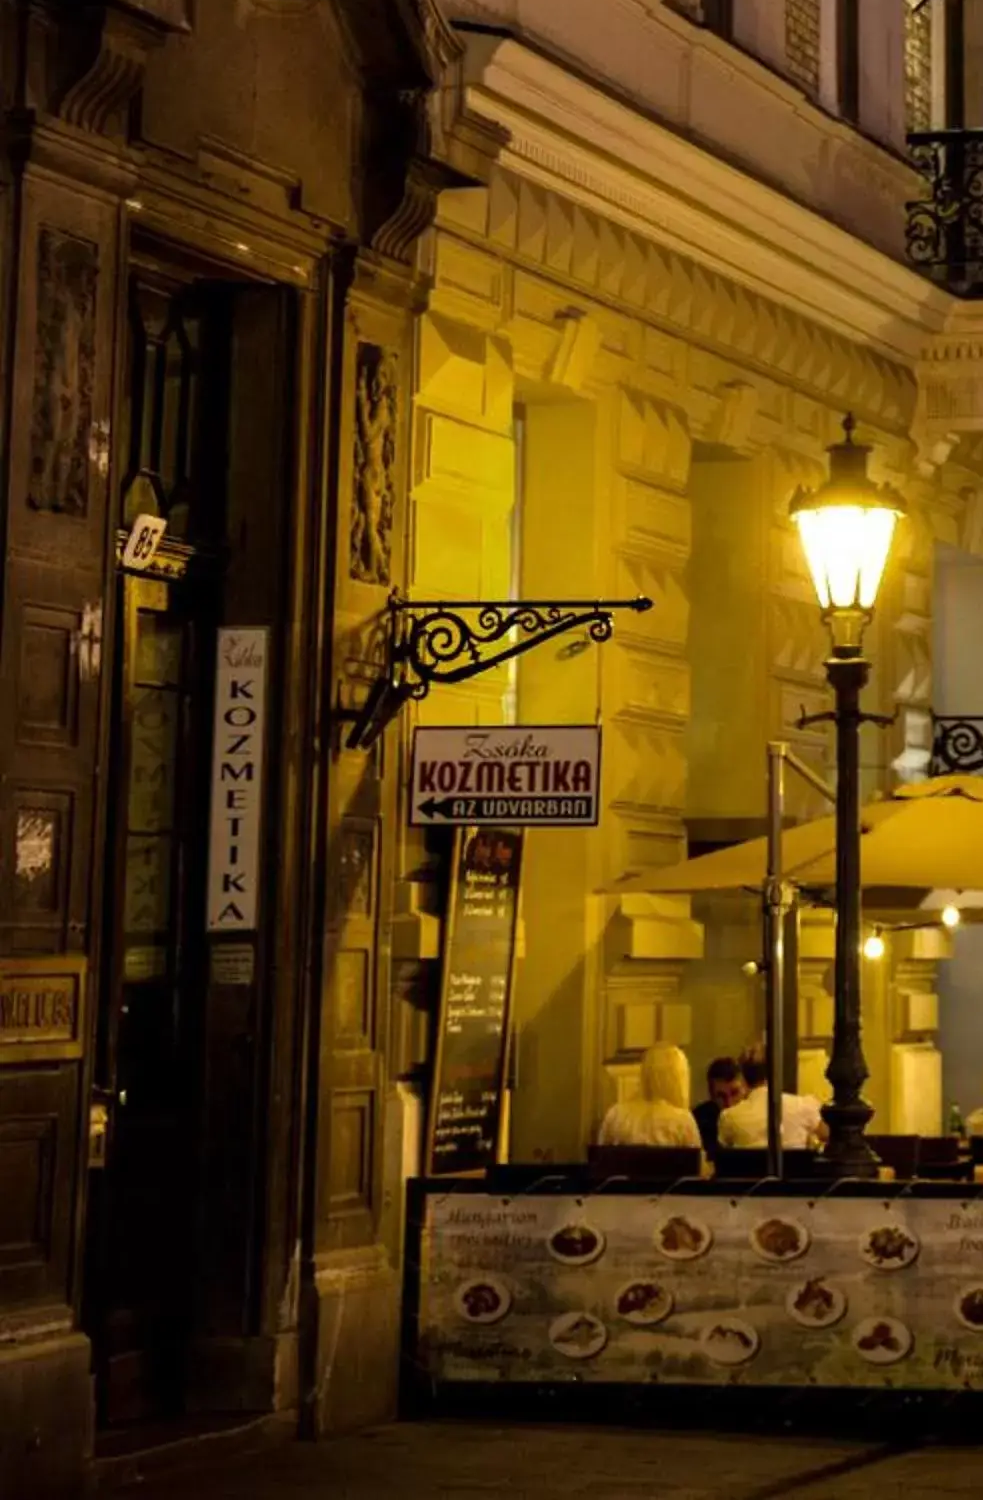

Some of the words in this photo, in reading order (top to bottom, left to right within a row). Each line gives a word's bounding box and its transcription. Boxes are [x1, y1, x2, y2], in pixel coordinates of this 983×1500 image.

[419, 761, 592, 793] KOZMETIKA
[218, 679, 257, 921] KOZMETIKA
[452, 800, 478, 817] AZ
[482, 799, 588, 817] UDVARBAN
